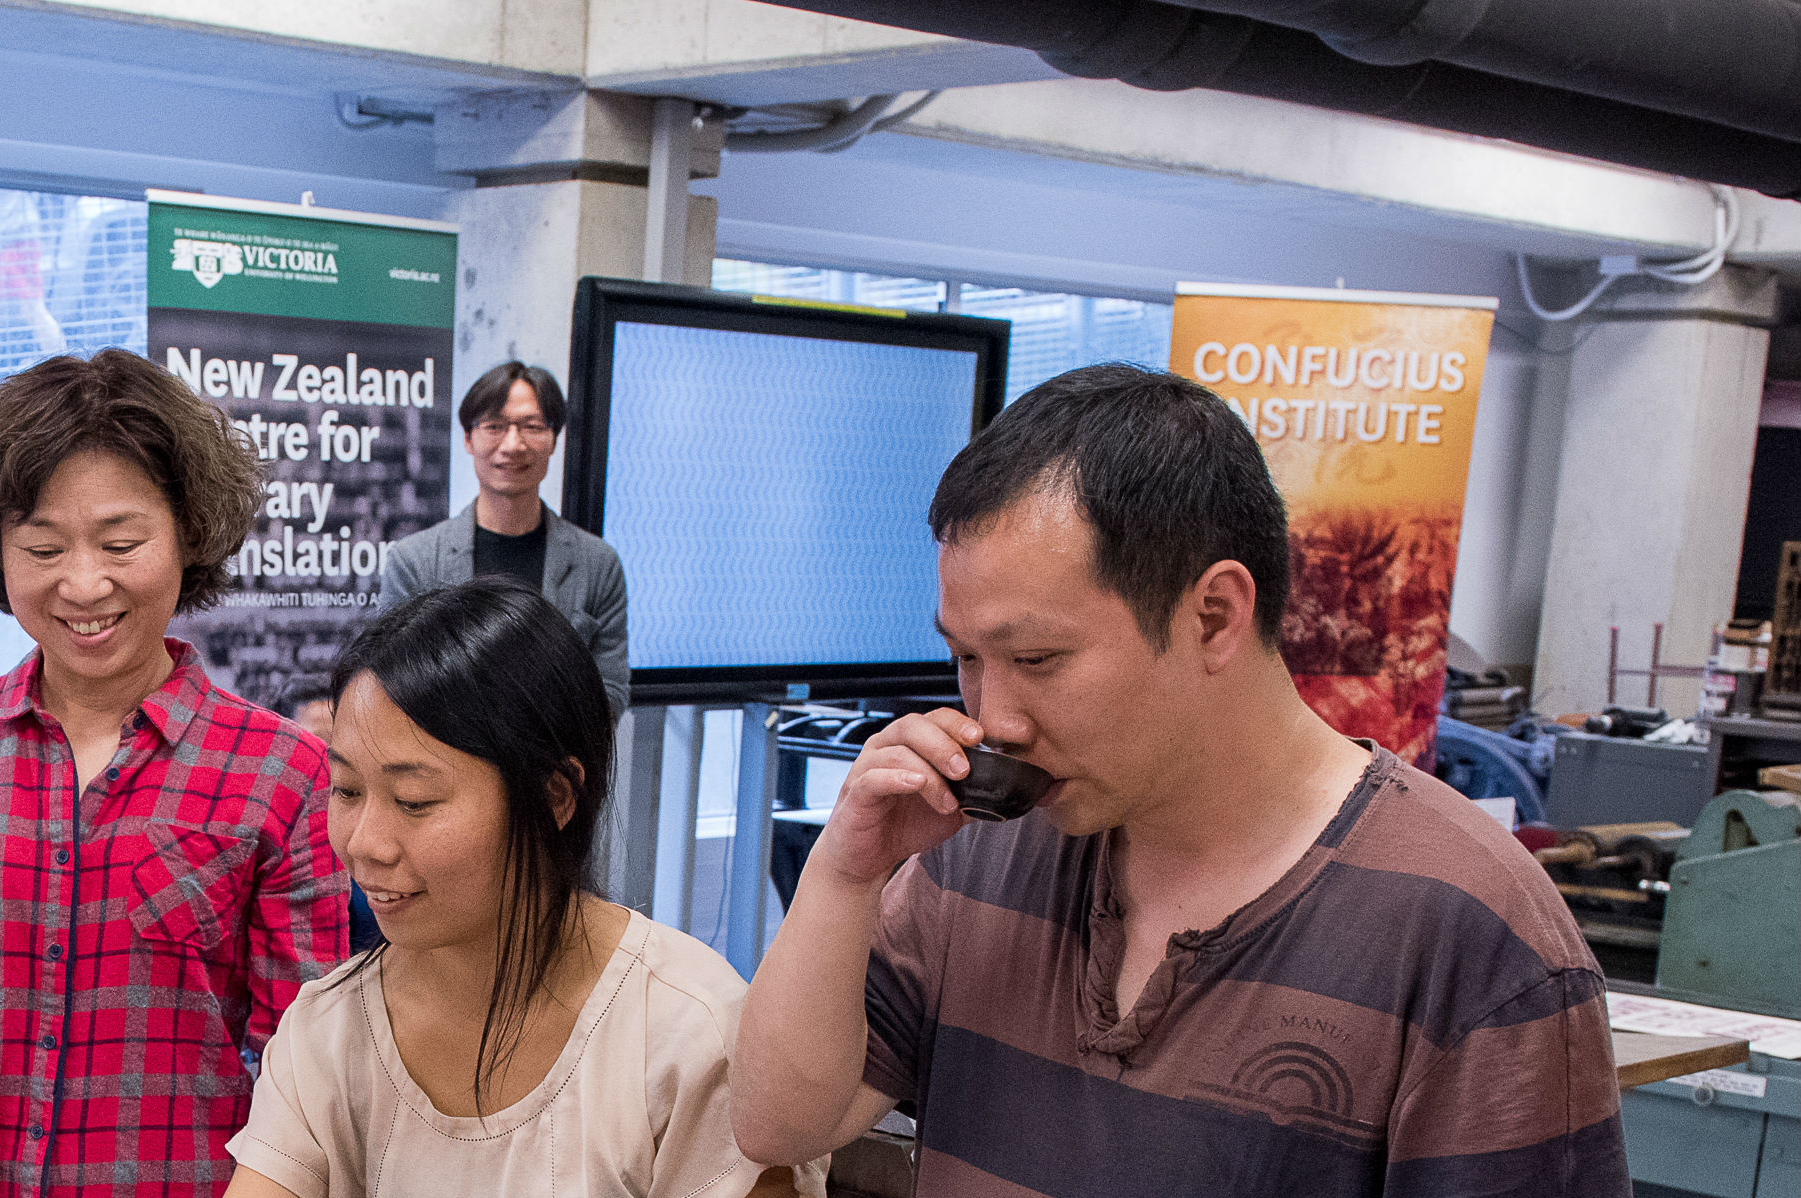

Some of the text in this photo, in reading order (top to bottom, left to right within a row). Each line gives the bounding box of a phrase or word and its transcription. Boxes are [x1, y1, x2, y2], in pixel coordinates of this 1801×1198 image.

[243, 245, 338, 274] VICTORIA
[167, 347, 435, 408] New Zealand
[1193, 341, 1466, 393] CONFUCIUS
[317, 409, 380, 463] for
[1229, 396, 1444, 444] NSTITUTE
